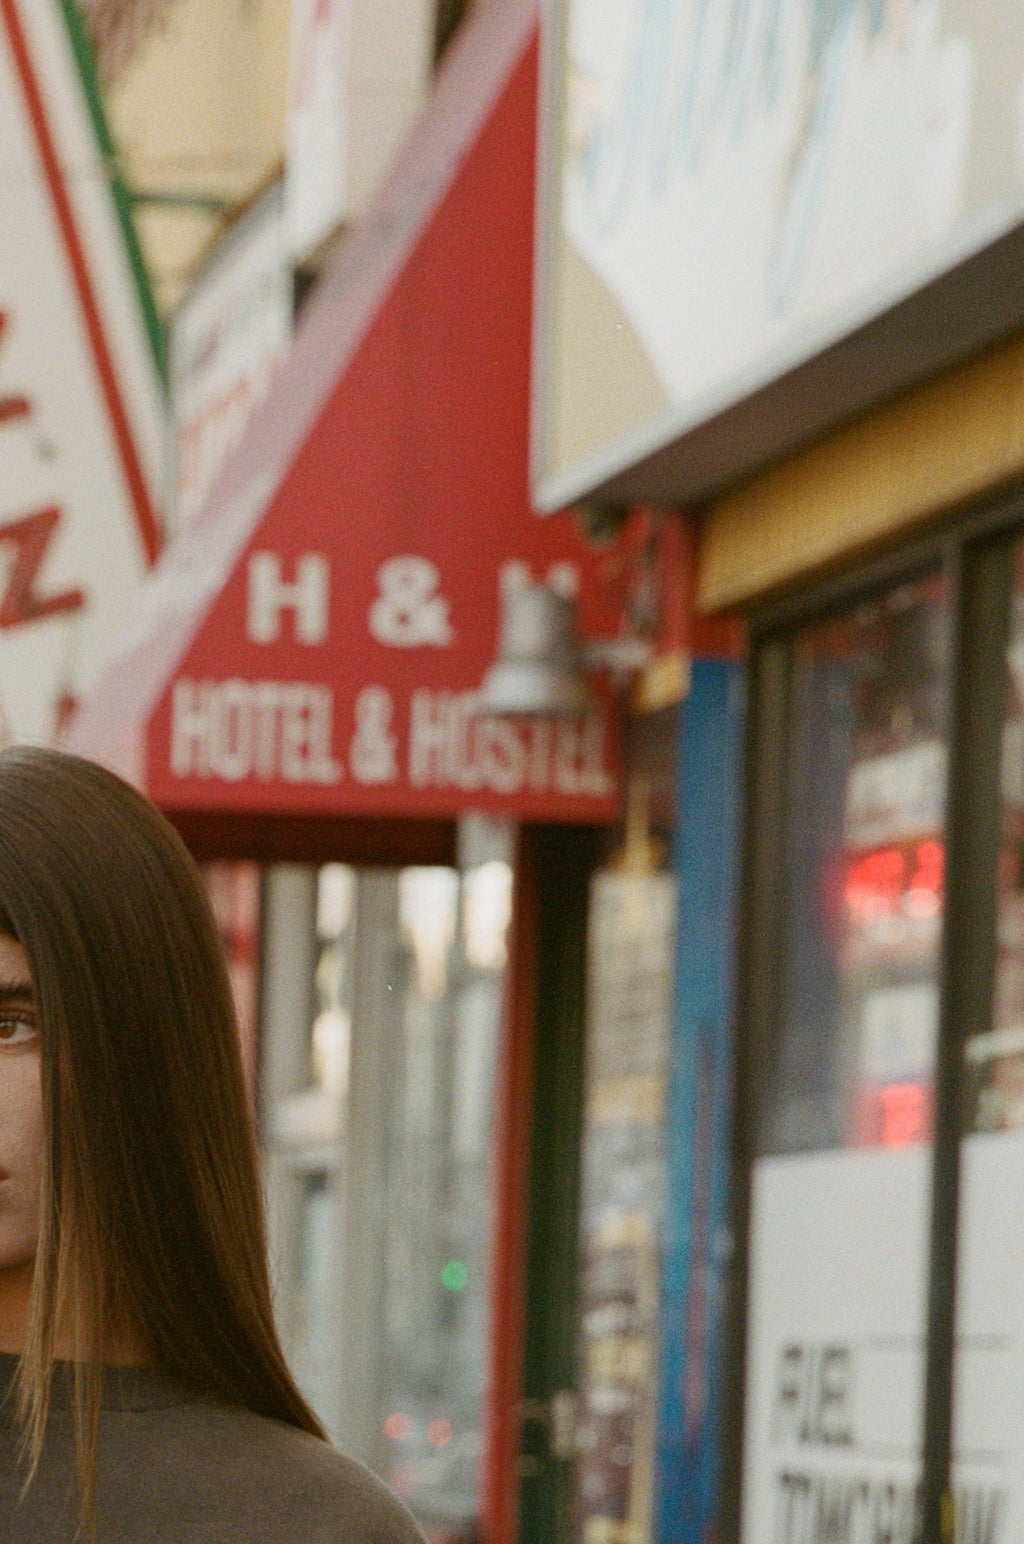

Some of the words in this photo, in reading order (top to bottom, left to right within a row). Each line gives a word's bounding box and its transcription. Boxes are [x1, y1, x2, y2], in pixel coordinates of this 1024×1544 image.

[246, 551, 329, 646] H
[369, 554, 456, 648] &
[170, 679, 340, 786] HOTEL
[350, 685, 398, 786] &
[409, 688, 615, 796] HOSTEL
